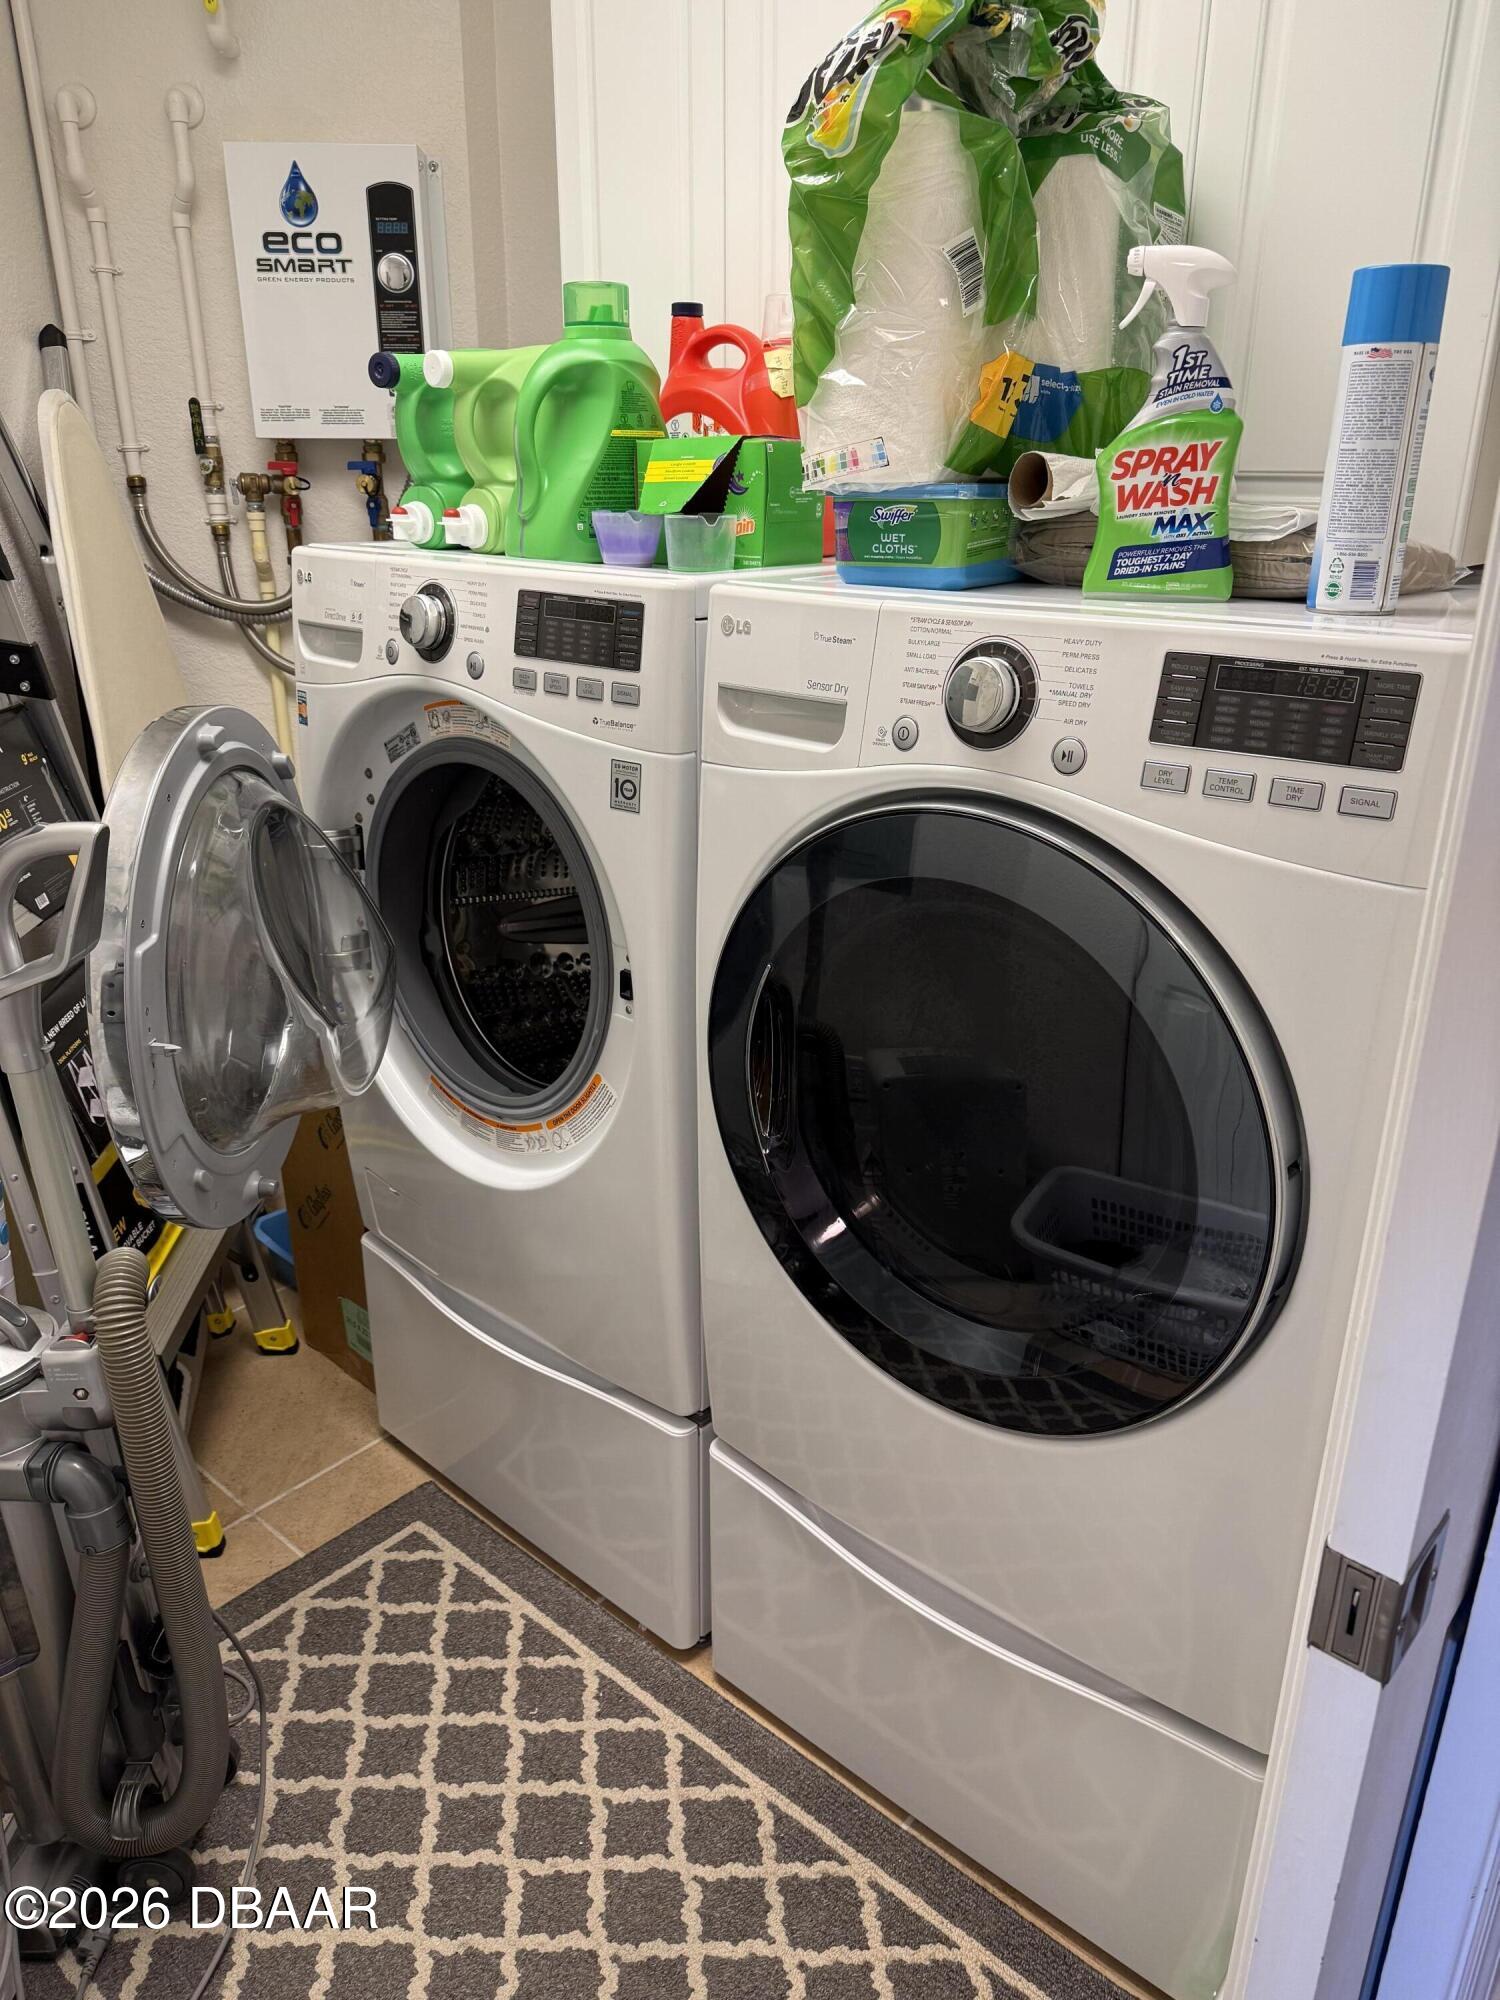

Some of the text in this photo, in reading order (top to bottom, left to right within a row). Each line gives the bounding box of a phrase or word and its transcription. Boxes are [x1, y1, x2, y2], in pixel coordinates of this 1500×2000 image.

[1080, 134, 1100, 148] USE
[262, 231, 343, 254] eco
[1174, 345, 1208, 371] 1ST
[1168, 365, 1211, 386] TIME
[1158, 378, 1220, 399] STAIN REMOVAL
[1155, 399, 1172, 408] EVEN
[1179, 392, 1197, 401] COLD
[1110, 440, 1223, 480] SPRAY
[1117, 475, 1219, 513] WASH
[870, 505, 915, 526] Swiffer
[736, 518, 754, 536] ain
[1151, 511, 1217, 537] MAX
[880, 533, 906, 543] WET
[1116, 551, 1193, 567] TOUGHEST 7-DAY
[1117, 548, 1161, 559] POWERFULLY
[1160, 544, 1193, 554] REMOVES
[1113, 561, 1186, 576] DRIED-IN STAINS
[1063, 638, 1103, 647] HEAVY DUTY
[906, 651, 922, 659] SMALL
[915, 667, 940, 675] BACTERIAL
[1064, 666, 1098, 675] DELICATES
[806, 679, 849, 696] Sensor Dry
[902, 681, 916, 689] STEAM
[1068, 682, 1095, 691] TOWELS
[899, 697, 916, 705] STEAM
[1057, 700, 1092, 709] SPEED DRY
[1158, 769, 1173, 778] DRY
[614, 777, 637, 801] 10
[1153, 777, 1176, 786] LEVEL
[1218, 777, 1239, 786] TEMP
[1209, 784, 1245, 795] CONTROL
[1285, 785, 1305, 795] TIME
[1285, 793, 1304, 802] DRY
[1350, 797, 1381, 808] SIGNAL
[47, 1024, 61, 1040] NEW
[58, 1010, 75, 1029] BREED
[73, 1003, 81, 1015] OF
[580, 1083, 596, 1105] SLIGHTLY
[112, 1215, 126, 1242] EW
[135, 1219, 157, 1248] BUCKET
